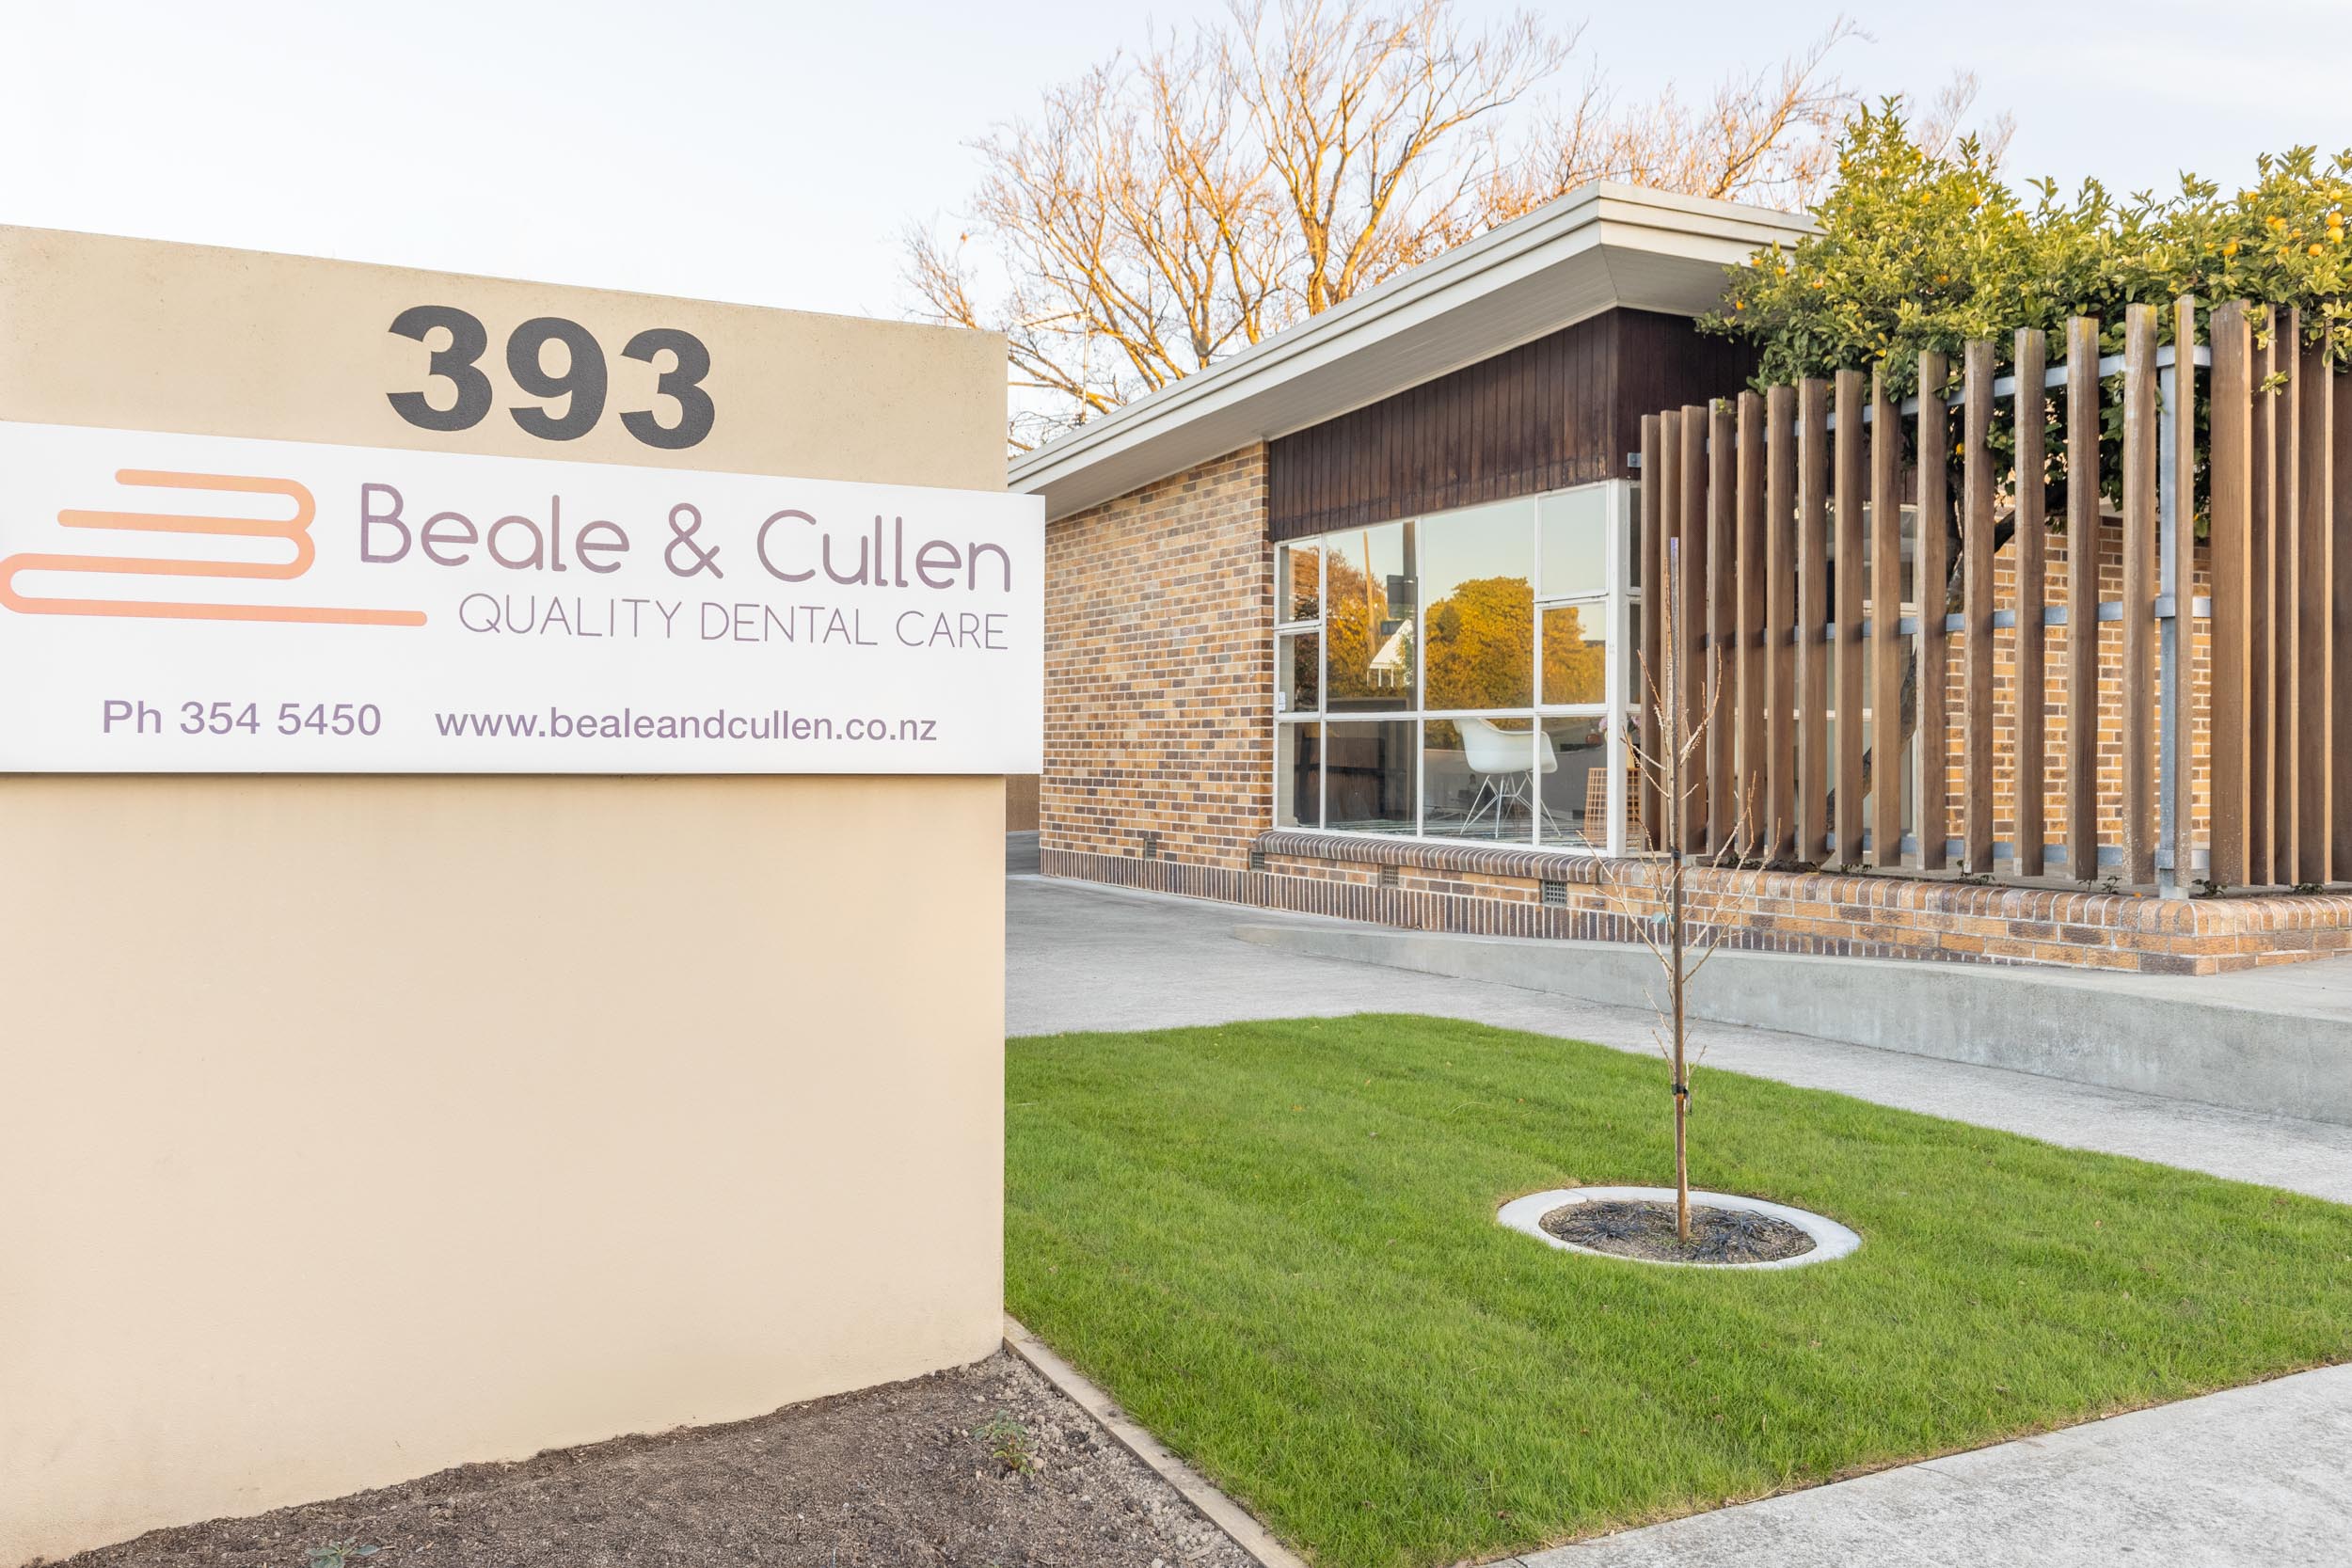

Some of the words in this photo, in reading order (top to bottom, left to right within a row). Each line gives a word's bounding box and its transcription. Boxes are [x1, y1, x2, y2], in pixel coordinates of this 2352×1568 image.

[387, 305, 715, 450] 393
[360, 483, 630, 575] Beale
[663, 502, 725, 580] &
[756, 509, 1011, 593] Cullen
[459, 593, 683, 639] QUALITY
[701, 602, 879, 646] DENTAL
[896, 610, 1009, 650] CARE
[103, 700, 162, 734] Ph
[180, 701, 262, 736] 354
[278, 703, 382, 736] 5450
[435, 706, 938, 741] www.bealeandcullen.co.nz
